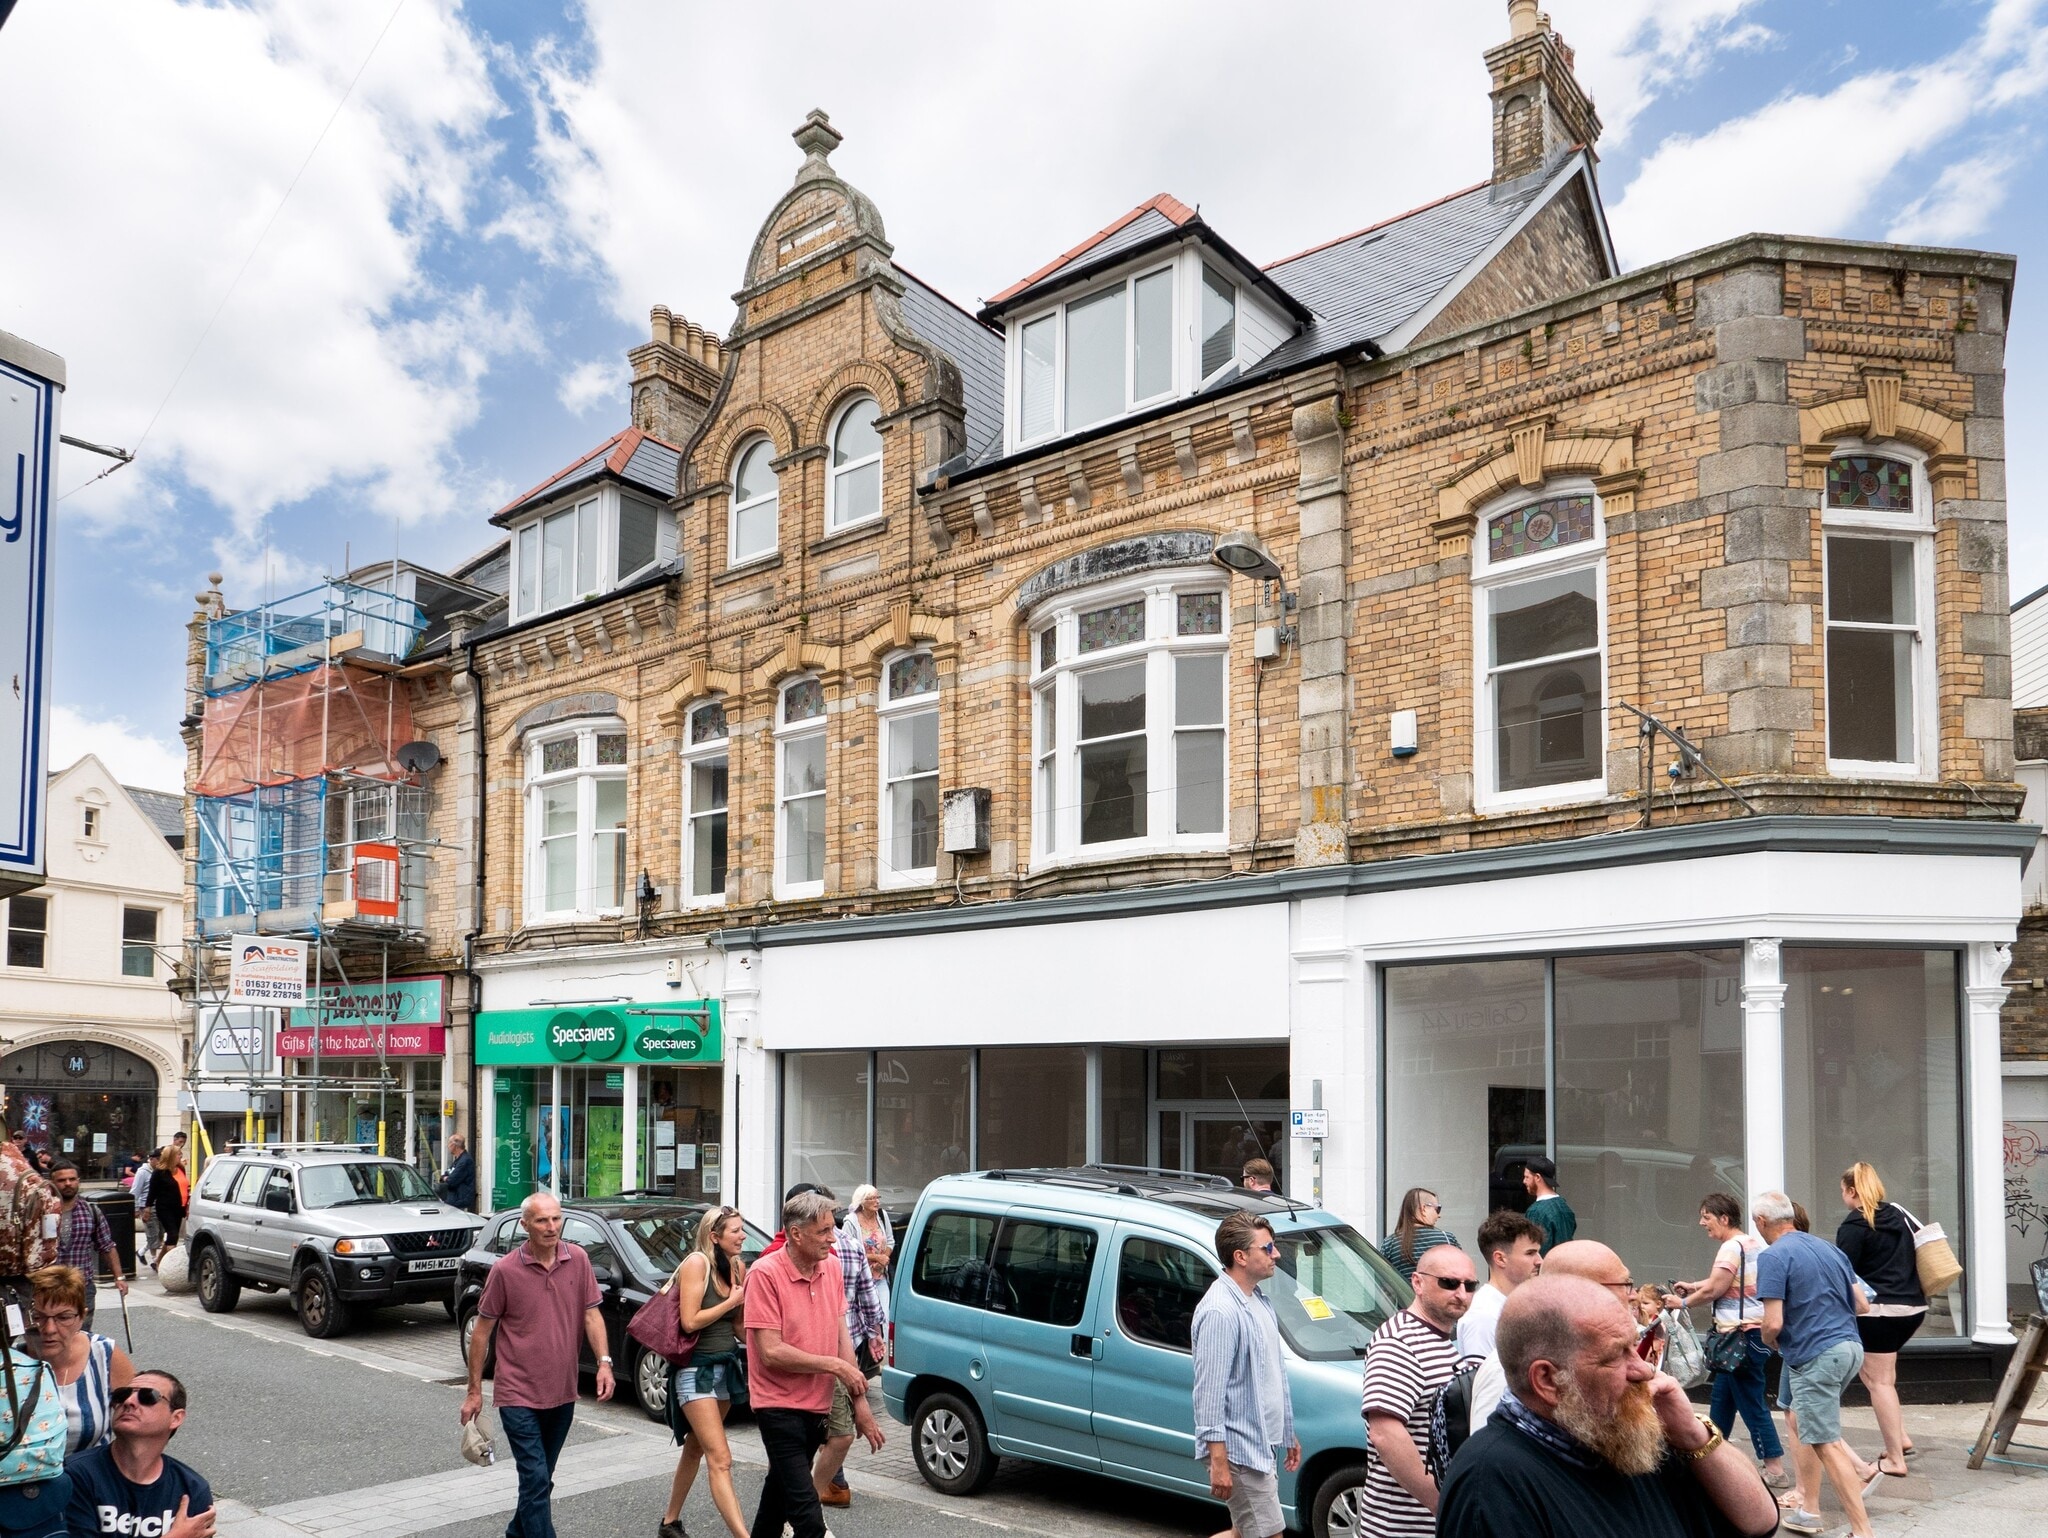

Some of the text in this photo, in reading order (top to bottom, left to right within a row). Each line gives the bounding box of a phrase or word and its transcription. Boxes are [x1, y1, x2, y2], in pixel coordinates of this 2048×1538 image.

[267, 947, 298, 956] RC
[246, 980, 270, 988] 01637
[272, 982, 302, 990] 621719
[246, 988, 270, 998] 07792
[272, 990, 302, 1000] 278798
[282, 1035, 305, 1053] Gifts
[326, 1035, 342, 1050] the
[390, 1034, 422, 1048] home
[488, 1030, 534, 1047] Audiologists
[552, 1026, 615, 1047] Specsavers
[642, 1037, 696, 1052] Specsavers
[508, 1094, 522, 1184] Contact Lenses
[438, 1258, 456, 1268] WZD
